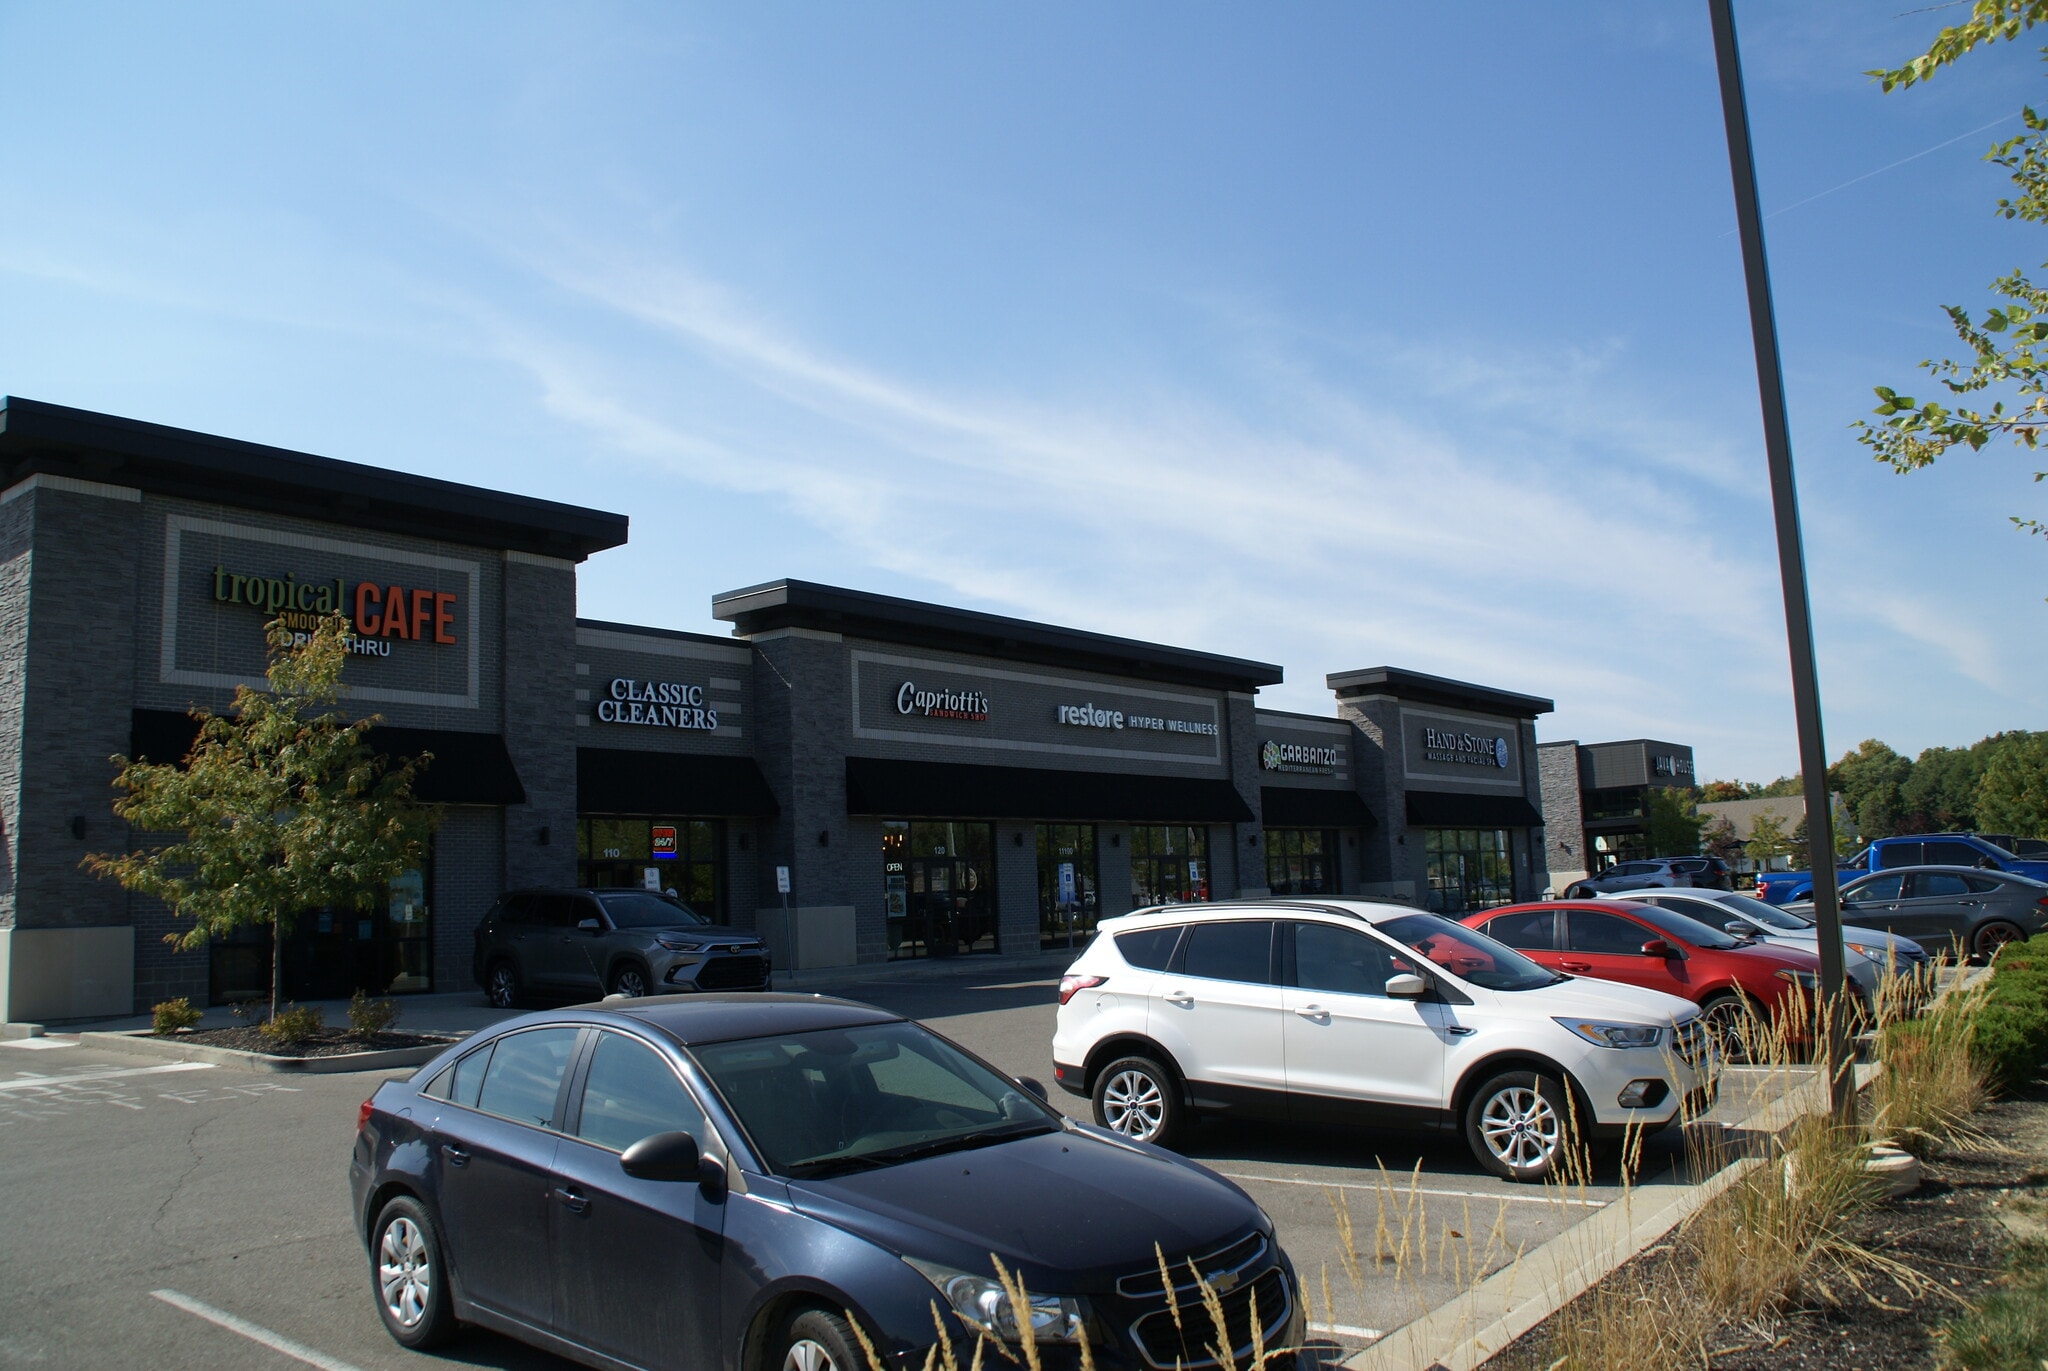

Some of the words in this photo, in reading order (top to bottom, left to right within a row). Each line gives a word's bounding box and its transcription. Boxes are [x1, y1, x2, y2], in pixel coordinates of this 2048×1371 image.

[213, 565, 345, 615] tropical
[279, 611, 343, 634] SMOO
[355, 582, 456, 645] CAFE
[343, 637, 391, 656] THRU
[611, 679, 703, 706] CLASSIC
[897, 681, 988, 716] Capriotti's
[598, 700, 718, 730] CLEANERS
[929, 708, 968, 720] SANDWICH
[1058, 702, 1124, 730] restore
[1128, 715, 1165, 731] HYPER
[1166, 719, 1218, 736] WELLNESS
[1426, 728, 1456, 750] HAND
[1457, 735, 1464, 751] &
[1464, 733, 1494, 755] STONE
[1280, 743, 1337, 766] GARBANZO
[1428, 752, 1454, 761] MASSAGE
[1455, 755, 1466, 763] AND
[1486, 757, 1496, 766] SPA
[603, 848, 620, 858] 110
[934, 846, 946, 855] 120
[887, 863, 903, 872] OPEN
